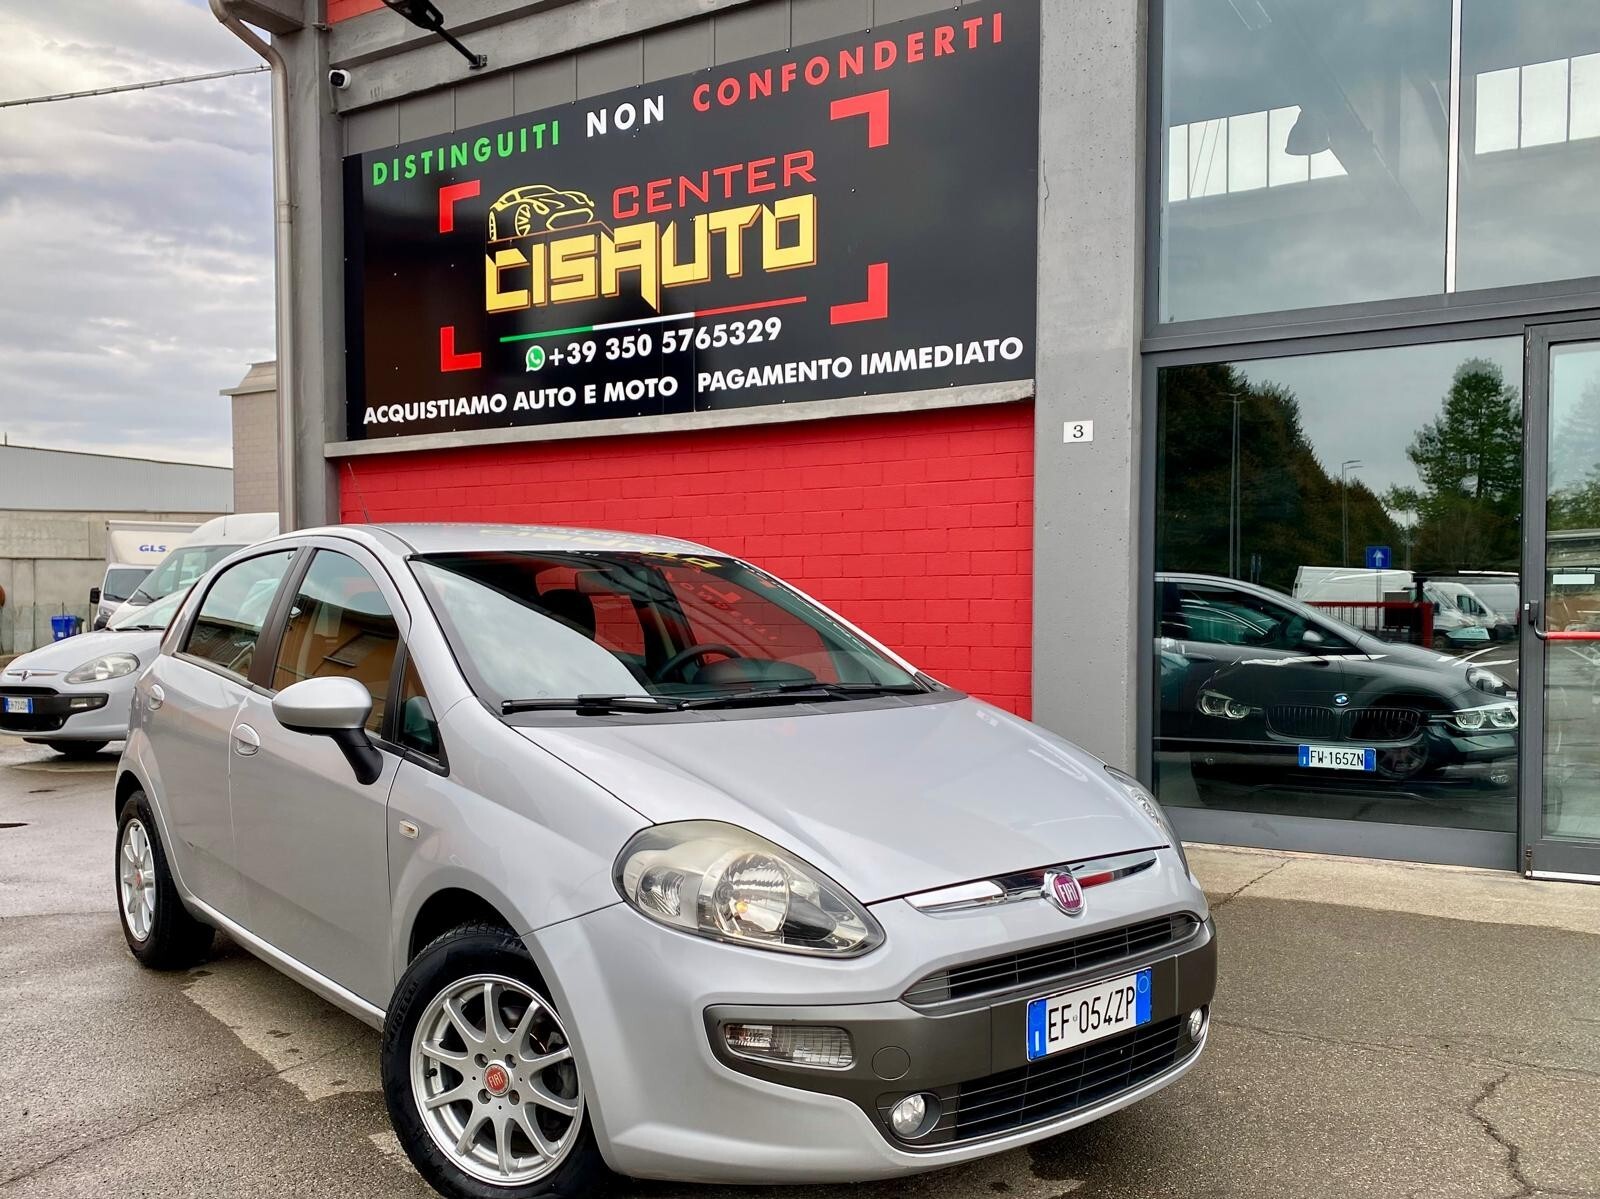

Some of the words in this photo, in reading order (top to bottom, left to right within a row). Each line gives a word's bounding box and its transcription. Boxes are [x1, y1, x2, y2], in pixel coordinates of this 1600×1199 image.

[373, 120, 559, 186] DISTINGUITI
[586, 94, 664, 138] NON
[692, 12, 1003, 112] CONFONDERTI
[612, 149, 817, 220] CENTER
[485, 193, 818, 314] CISAUTO
[548, 340, 597, 366] +39
[605, 333, 653, 361] 350
[661, 316, 782, 354] 5765329
[697, 356, 853, 393] PAGAMENTO
[860, 336, 1024, 376] IMMEDIATO
[363, 393, 508, 425] ACQUISTIAMO
[512, 386, 577, 411] AUTO
[584, 384, 597, 405] E
[603, 376, 679, 403] MOTO
[1073, 424, 1084, 439] 3
[139, 544, 167, 553] GLS
[1310, 750, 1324, 764] FW
[1328, 751, 1364, 767] 165ZN
[1058, 882, 1079, 903] FIAT
[1048, 1003, 1072, 1043] EF
[1079, 986, 1135, 1034] 054ZP
[488, 1071, 504, 1088] FIAT
